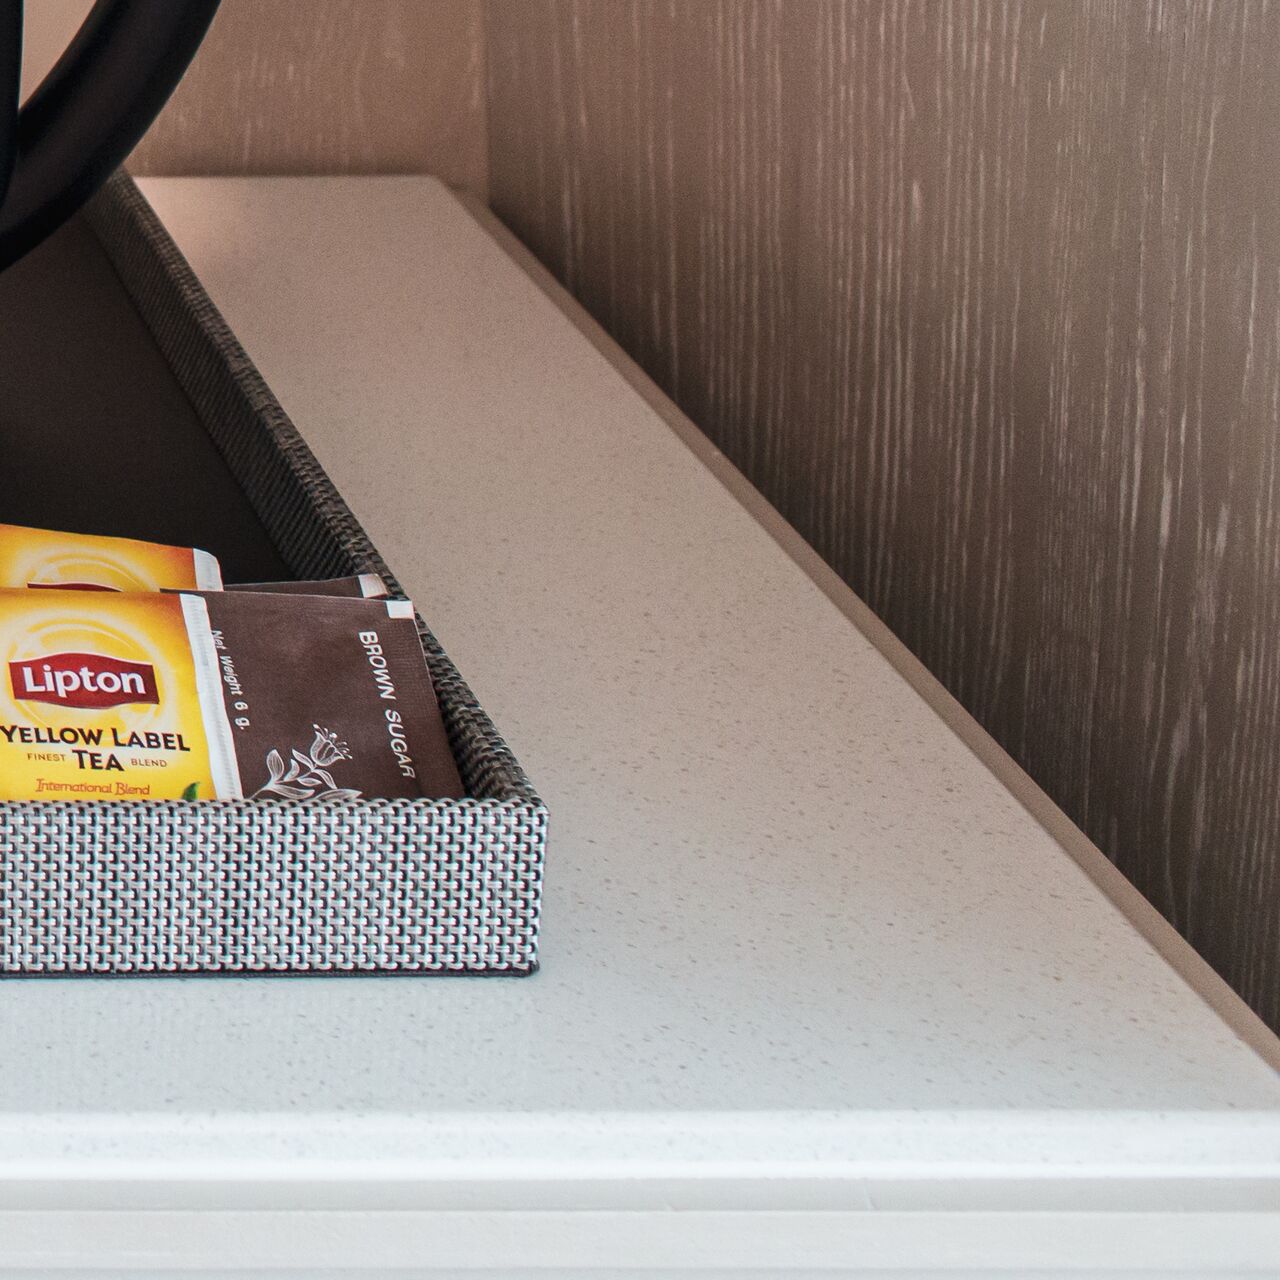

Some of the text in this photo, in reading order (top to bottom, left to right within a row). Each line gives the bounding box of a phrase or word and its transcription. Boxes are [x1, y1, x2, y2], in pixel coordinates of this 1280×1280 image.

[22, 665, 146, 699] Lipton
[211, 629, 225, 650] Net
[219, 654, 243, 695] Weight
[234, 701, 249, 711] 6
[357, 631, 416, 779] BROWN SUGAR
[112, 728, 191, 752] LABEL
[26, 749, 168, 772] FINEST TEA BLEND
[35, 778, 151, 796] International Blend
